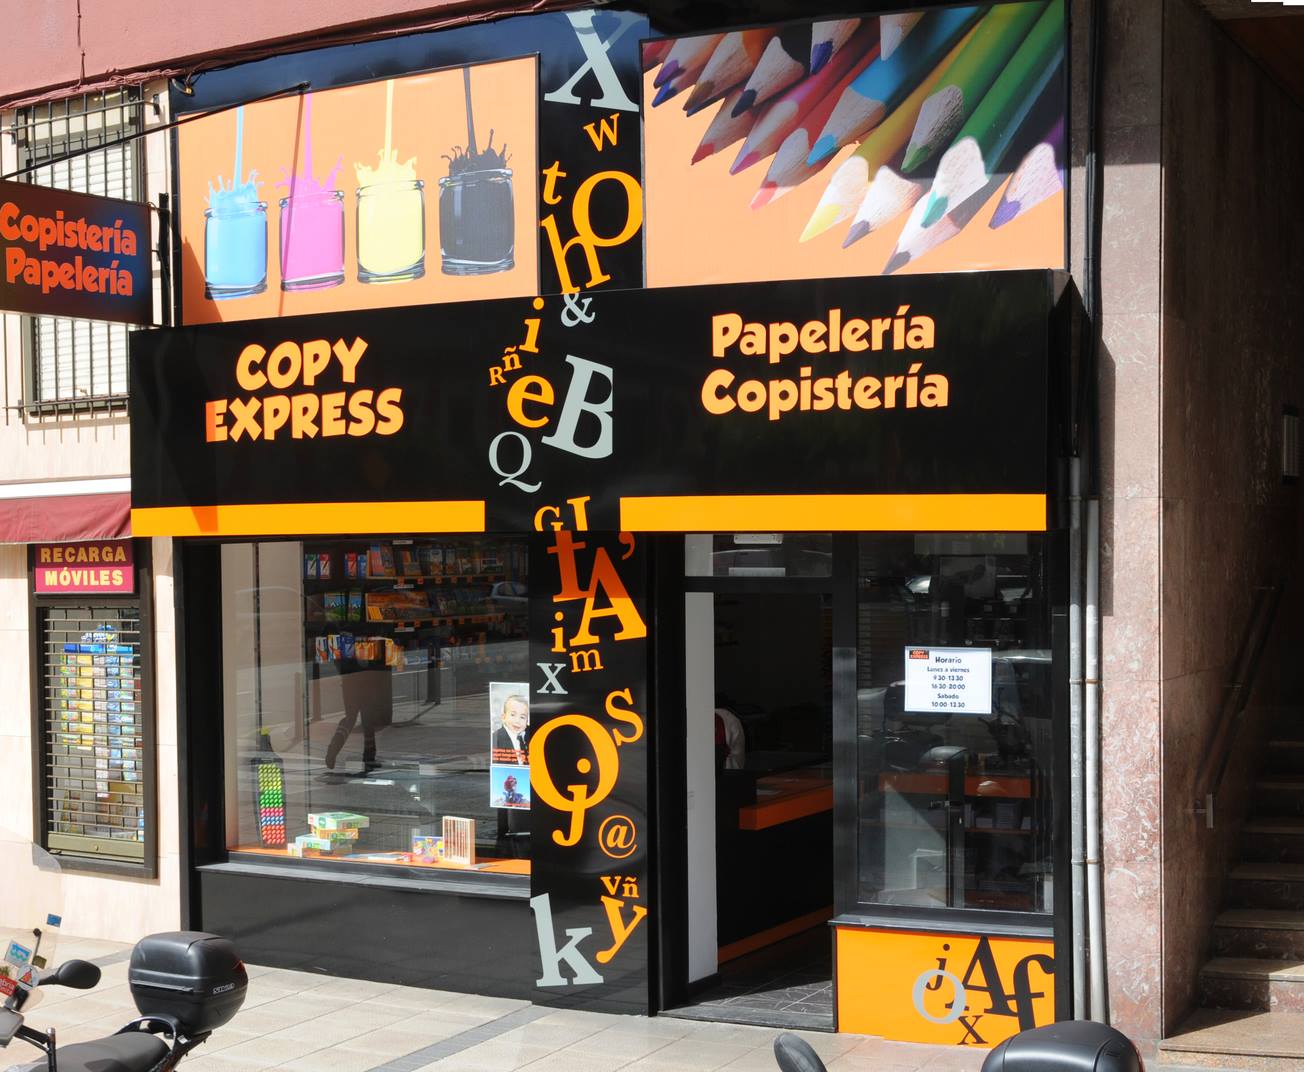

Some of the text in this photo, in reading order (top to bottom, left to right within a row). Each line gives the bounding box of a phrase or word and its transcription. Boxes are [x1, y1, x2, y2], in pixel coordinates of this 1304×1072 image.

[5, 247, 133, 296] Papelería
[712, 305, 935, 364] Papelería
[236, 336, 368, 391] COPY
[205, 387, 404, 443] EXPRESS
[701, 363, 949, 421] Copistería
[40, 546, 127, 563] RECARGA
[44, 567, 124, 586] MÓVILES
[935, 656, 962, 664] Horario
